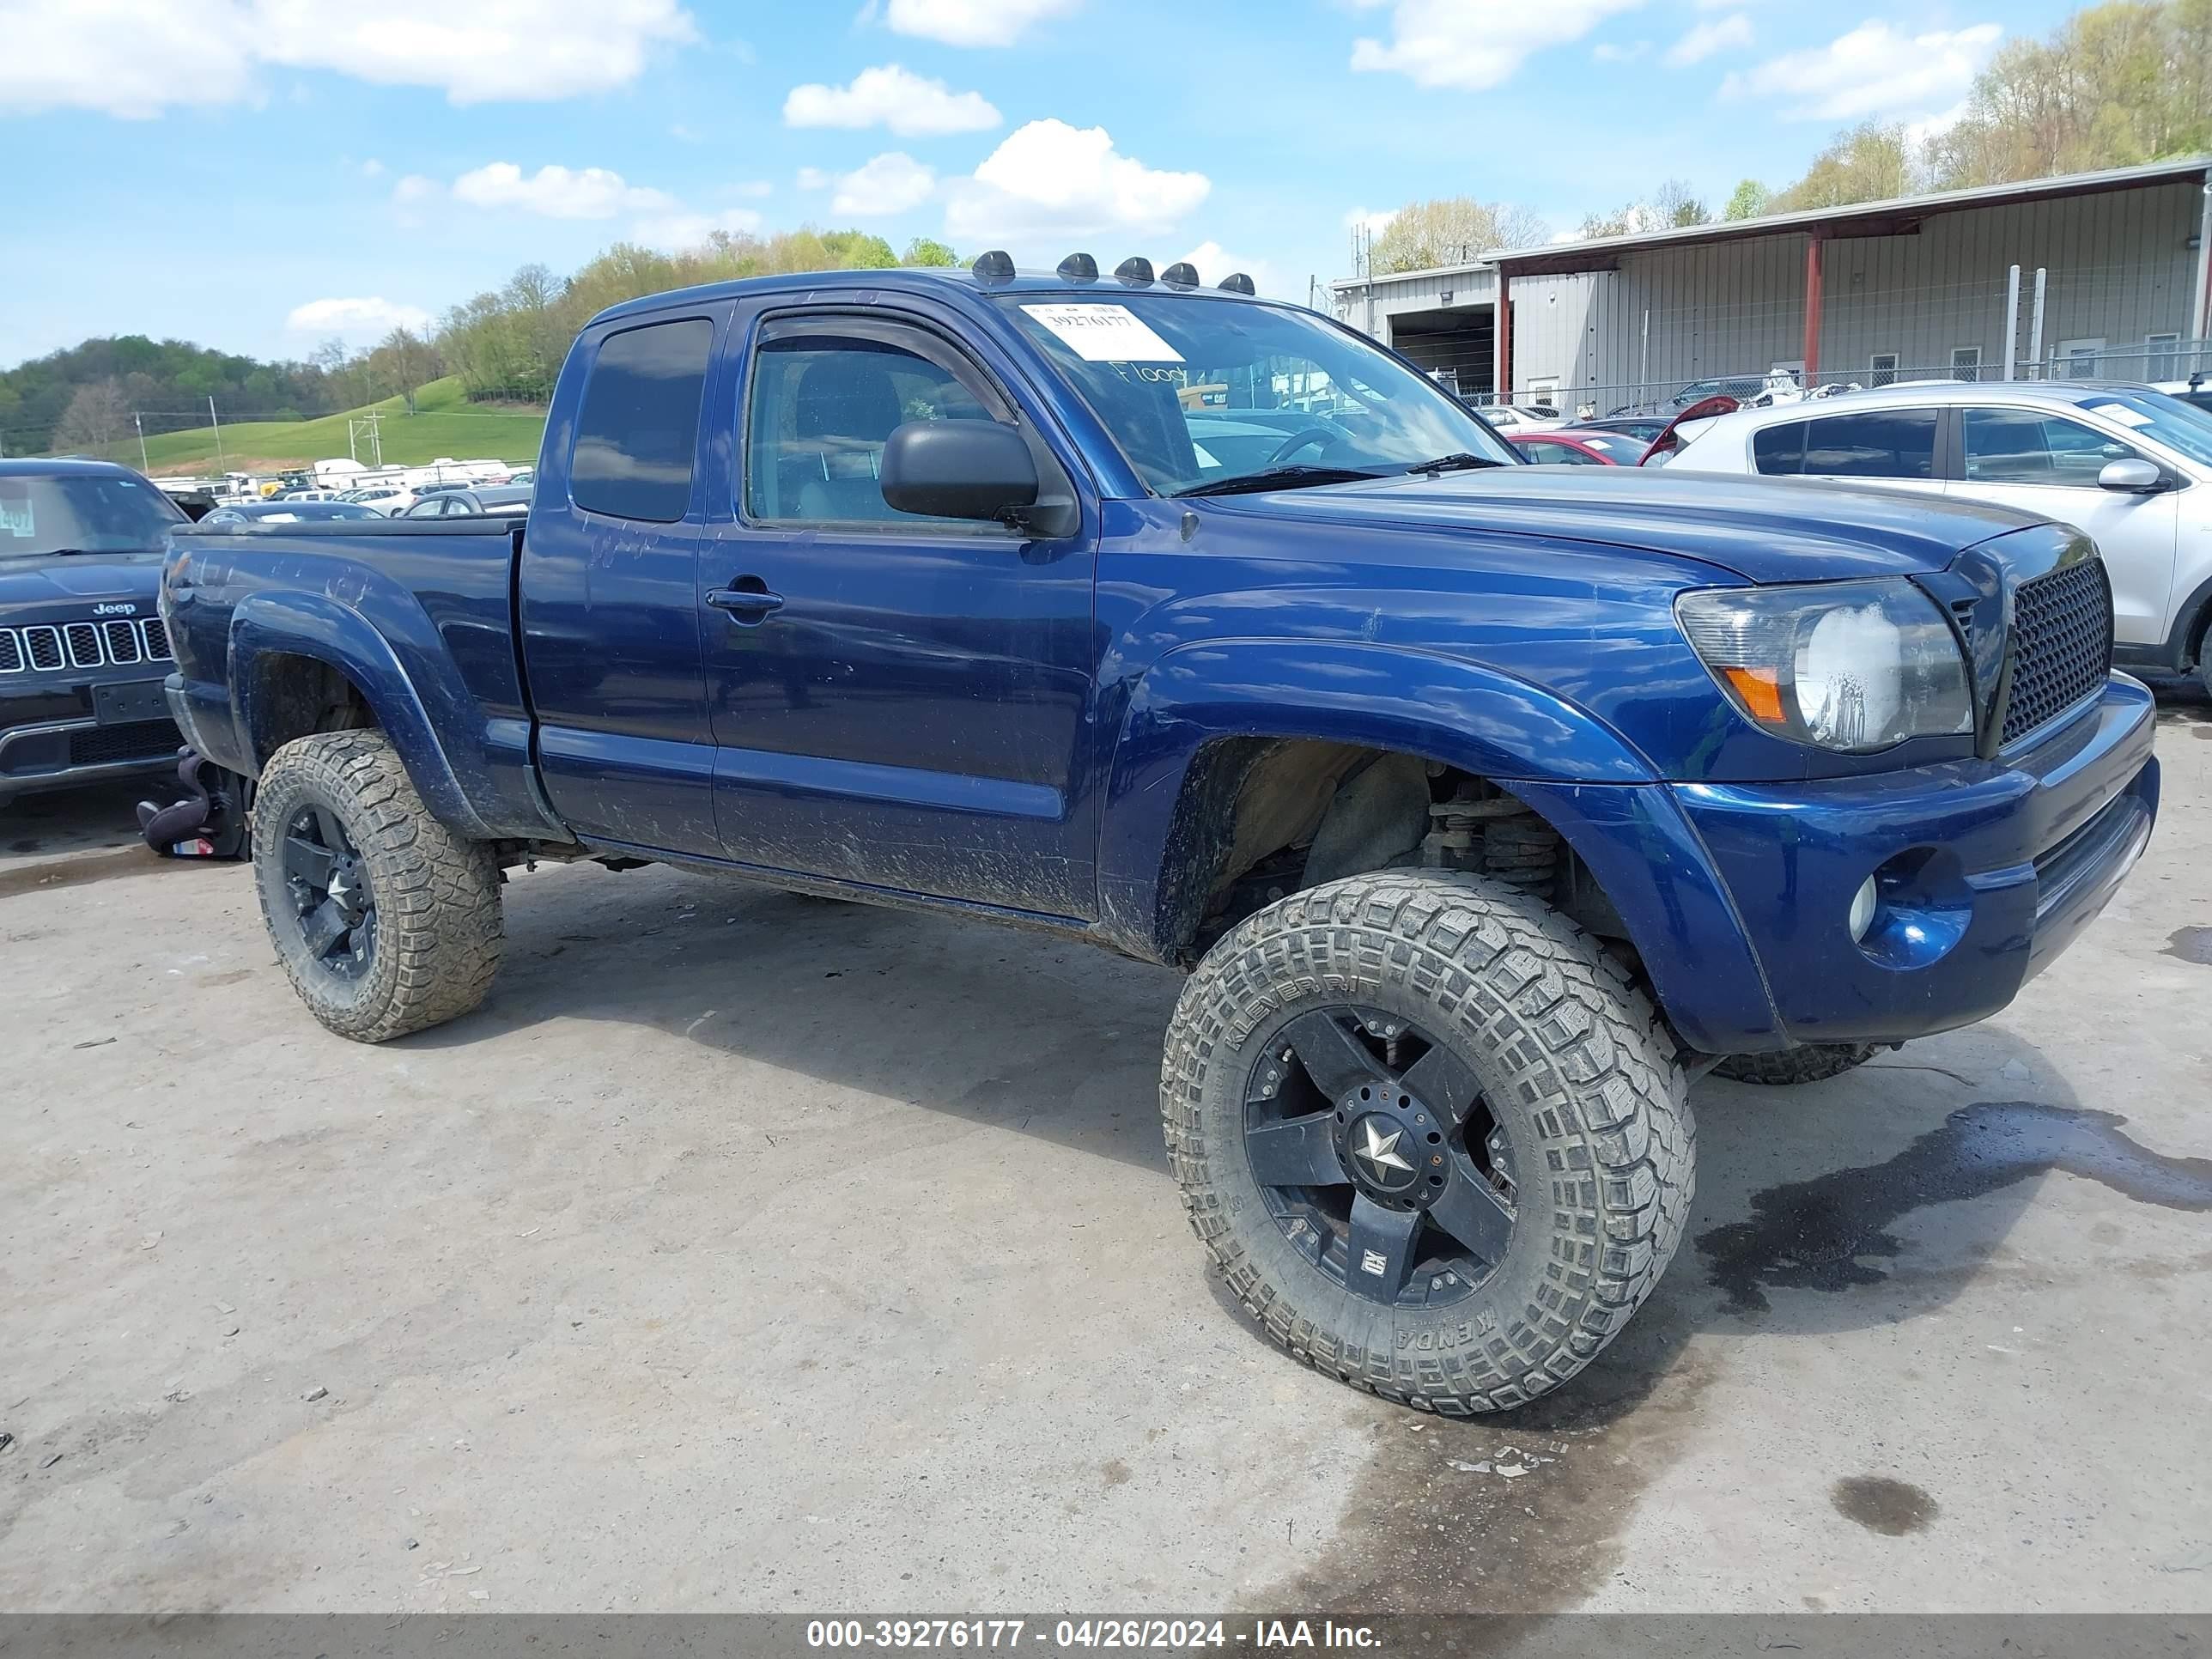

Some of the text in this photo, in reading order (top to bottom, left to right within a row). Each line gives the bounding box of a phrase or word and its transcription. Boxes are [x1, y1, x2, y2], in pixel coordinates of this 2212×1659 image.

[1046, 315, 1132, 327] 39276177
[1213, 393, 1227, 404] CAT
[93, 603, 137, 615] Jeep
[1223, 975, 1322, 1052] KLEVER
[1395, 1305, 1497, 1351] KENDA
